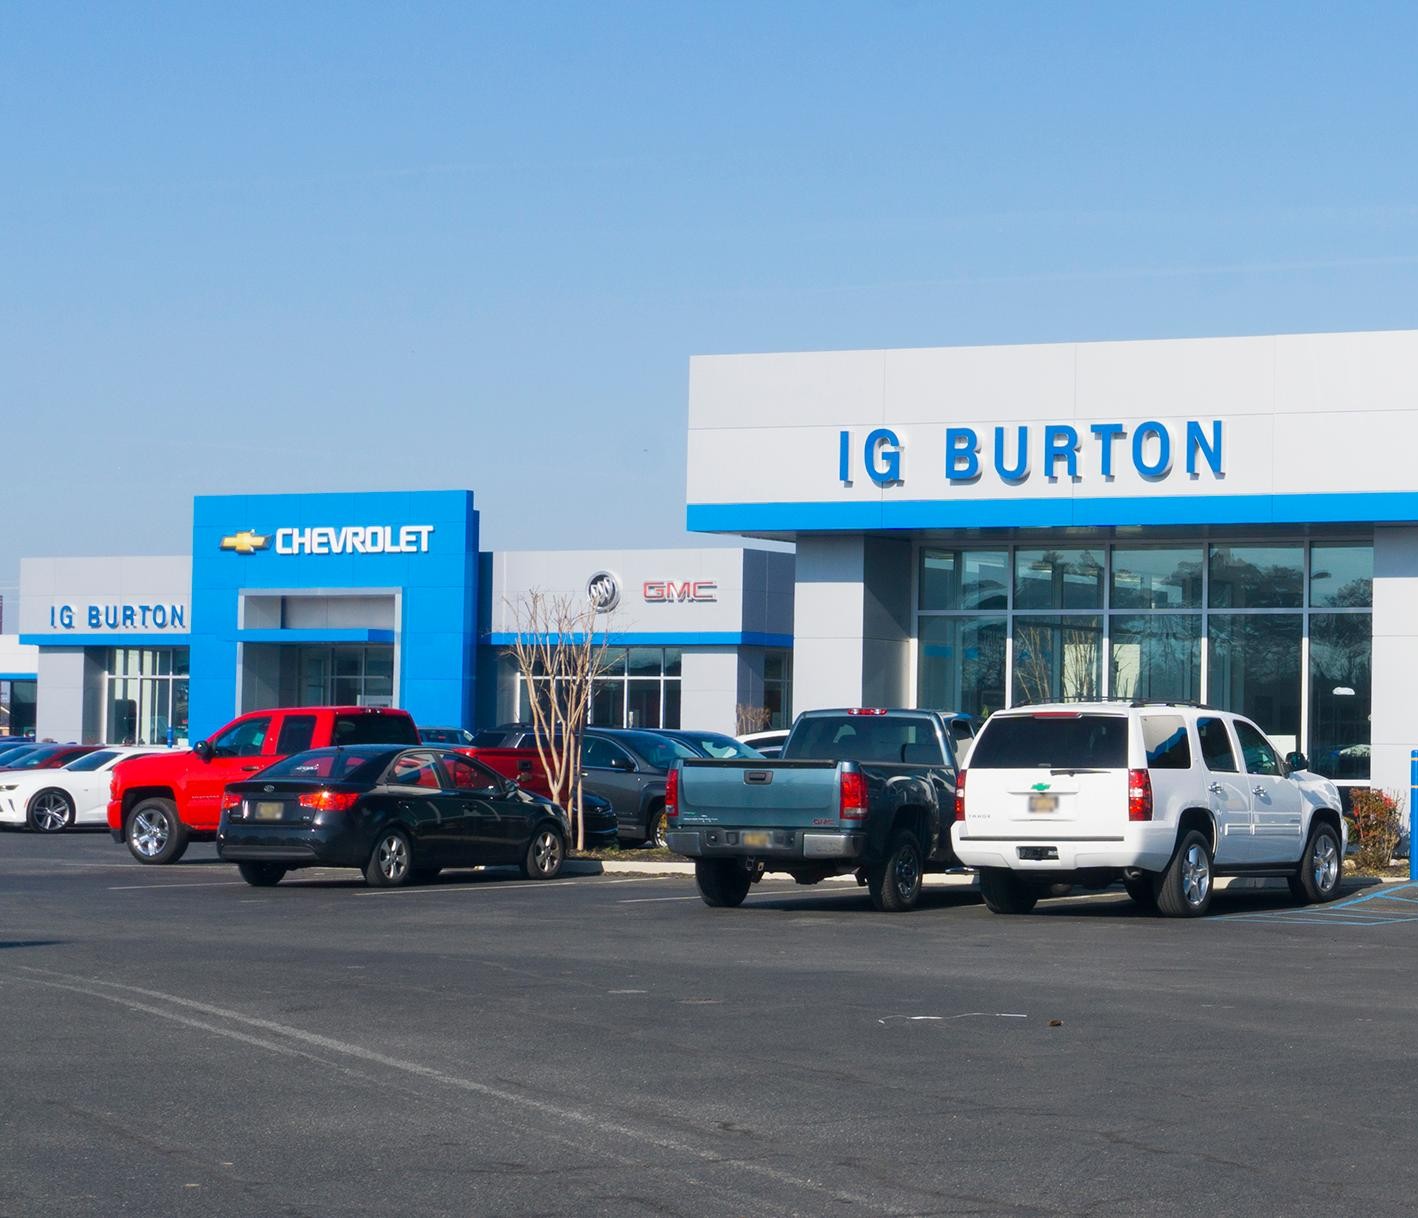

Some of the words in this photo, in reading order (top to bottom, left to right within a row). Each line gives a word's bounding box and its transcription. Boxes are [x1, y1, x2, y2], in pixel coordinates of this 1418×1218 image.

[839, 428, 903, 486] IG
[945, 420, 1224, 485] BURTON
[275, 525, 434, 554] CHEVROLET
[643, 581, 716, 602] GMC
[50, 605, 75, 629] IG
[88, 605, 185, 629] BURTON
